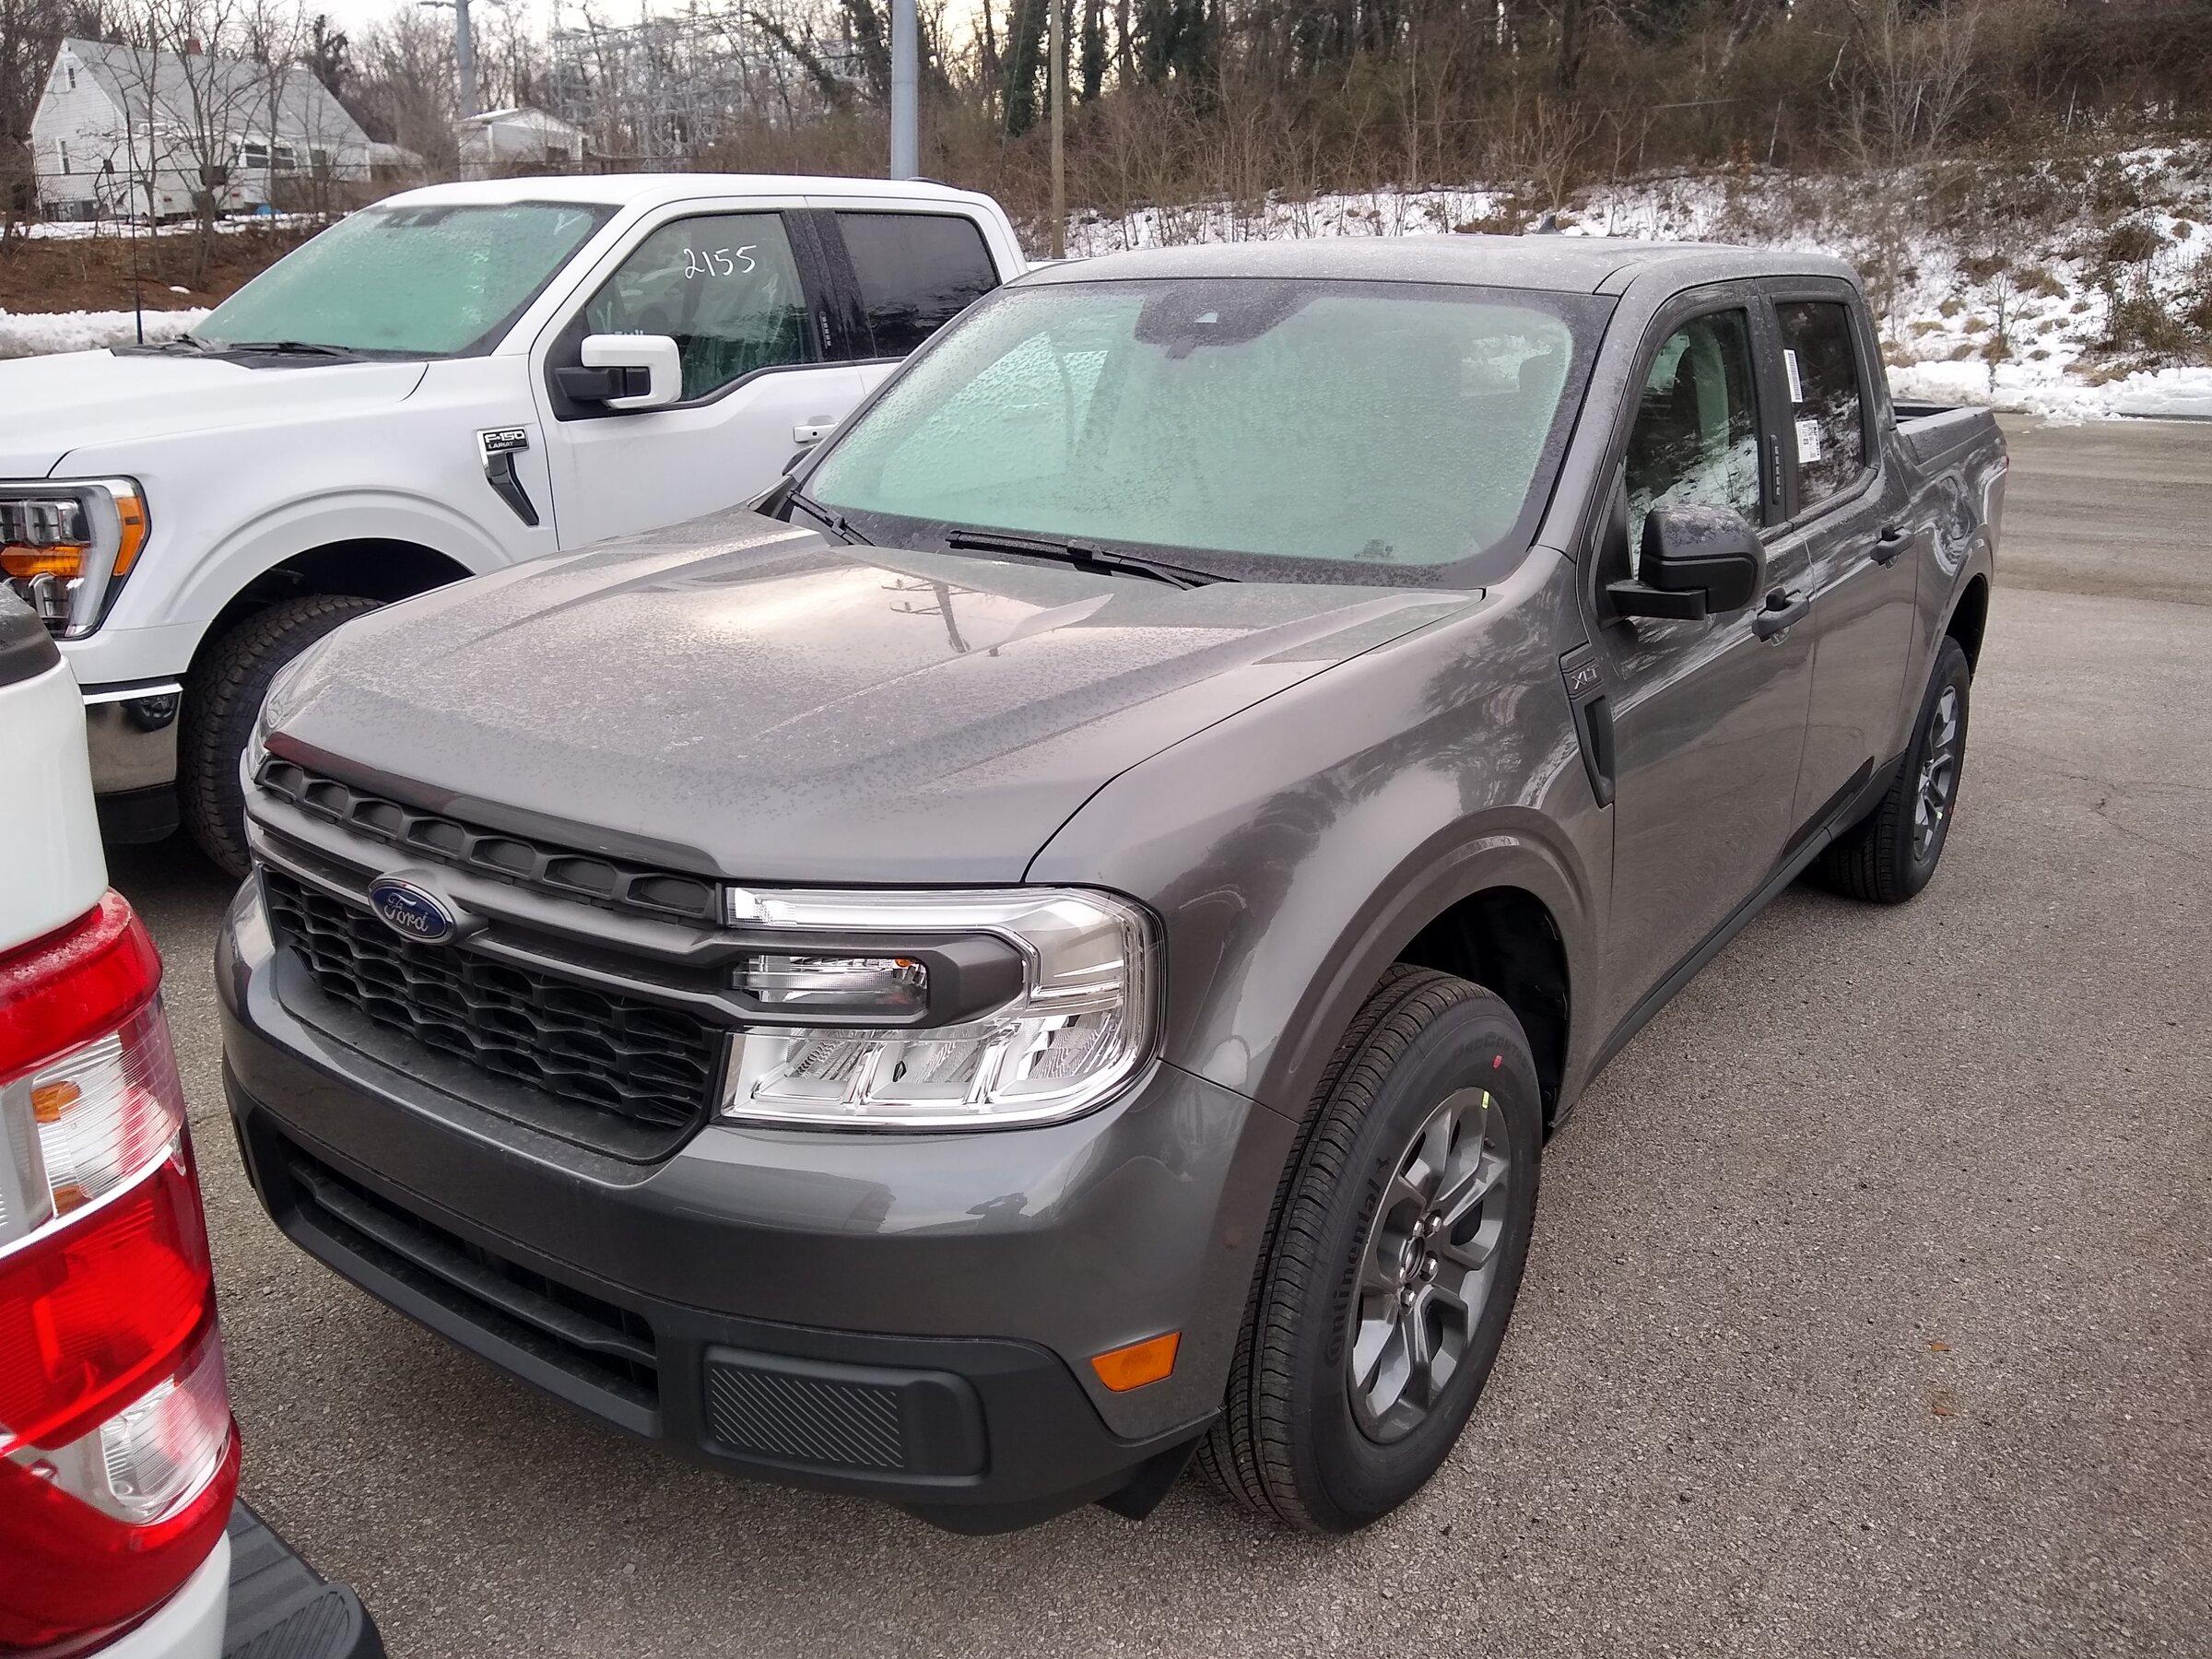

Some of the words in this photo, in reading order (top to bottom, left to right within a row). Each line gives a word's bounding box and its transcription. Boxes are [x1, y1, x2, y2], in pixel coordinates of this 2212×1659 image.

[683, 245, 757, 279] 2155
[484, 430, 525, 443] F-150
[1571, 664, 1599, 690] XLT
[383, 892, 429, 932] Ford
[1324, 1178, 1381, 1368] Continental
